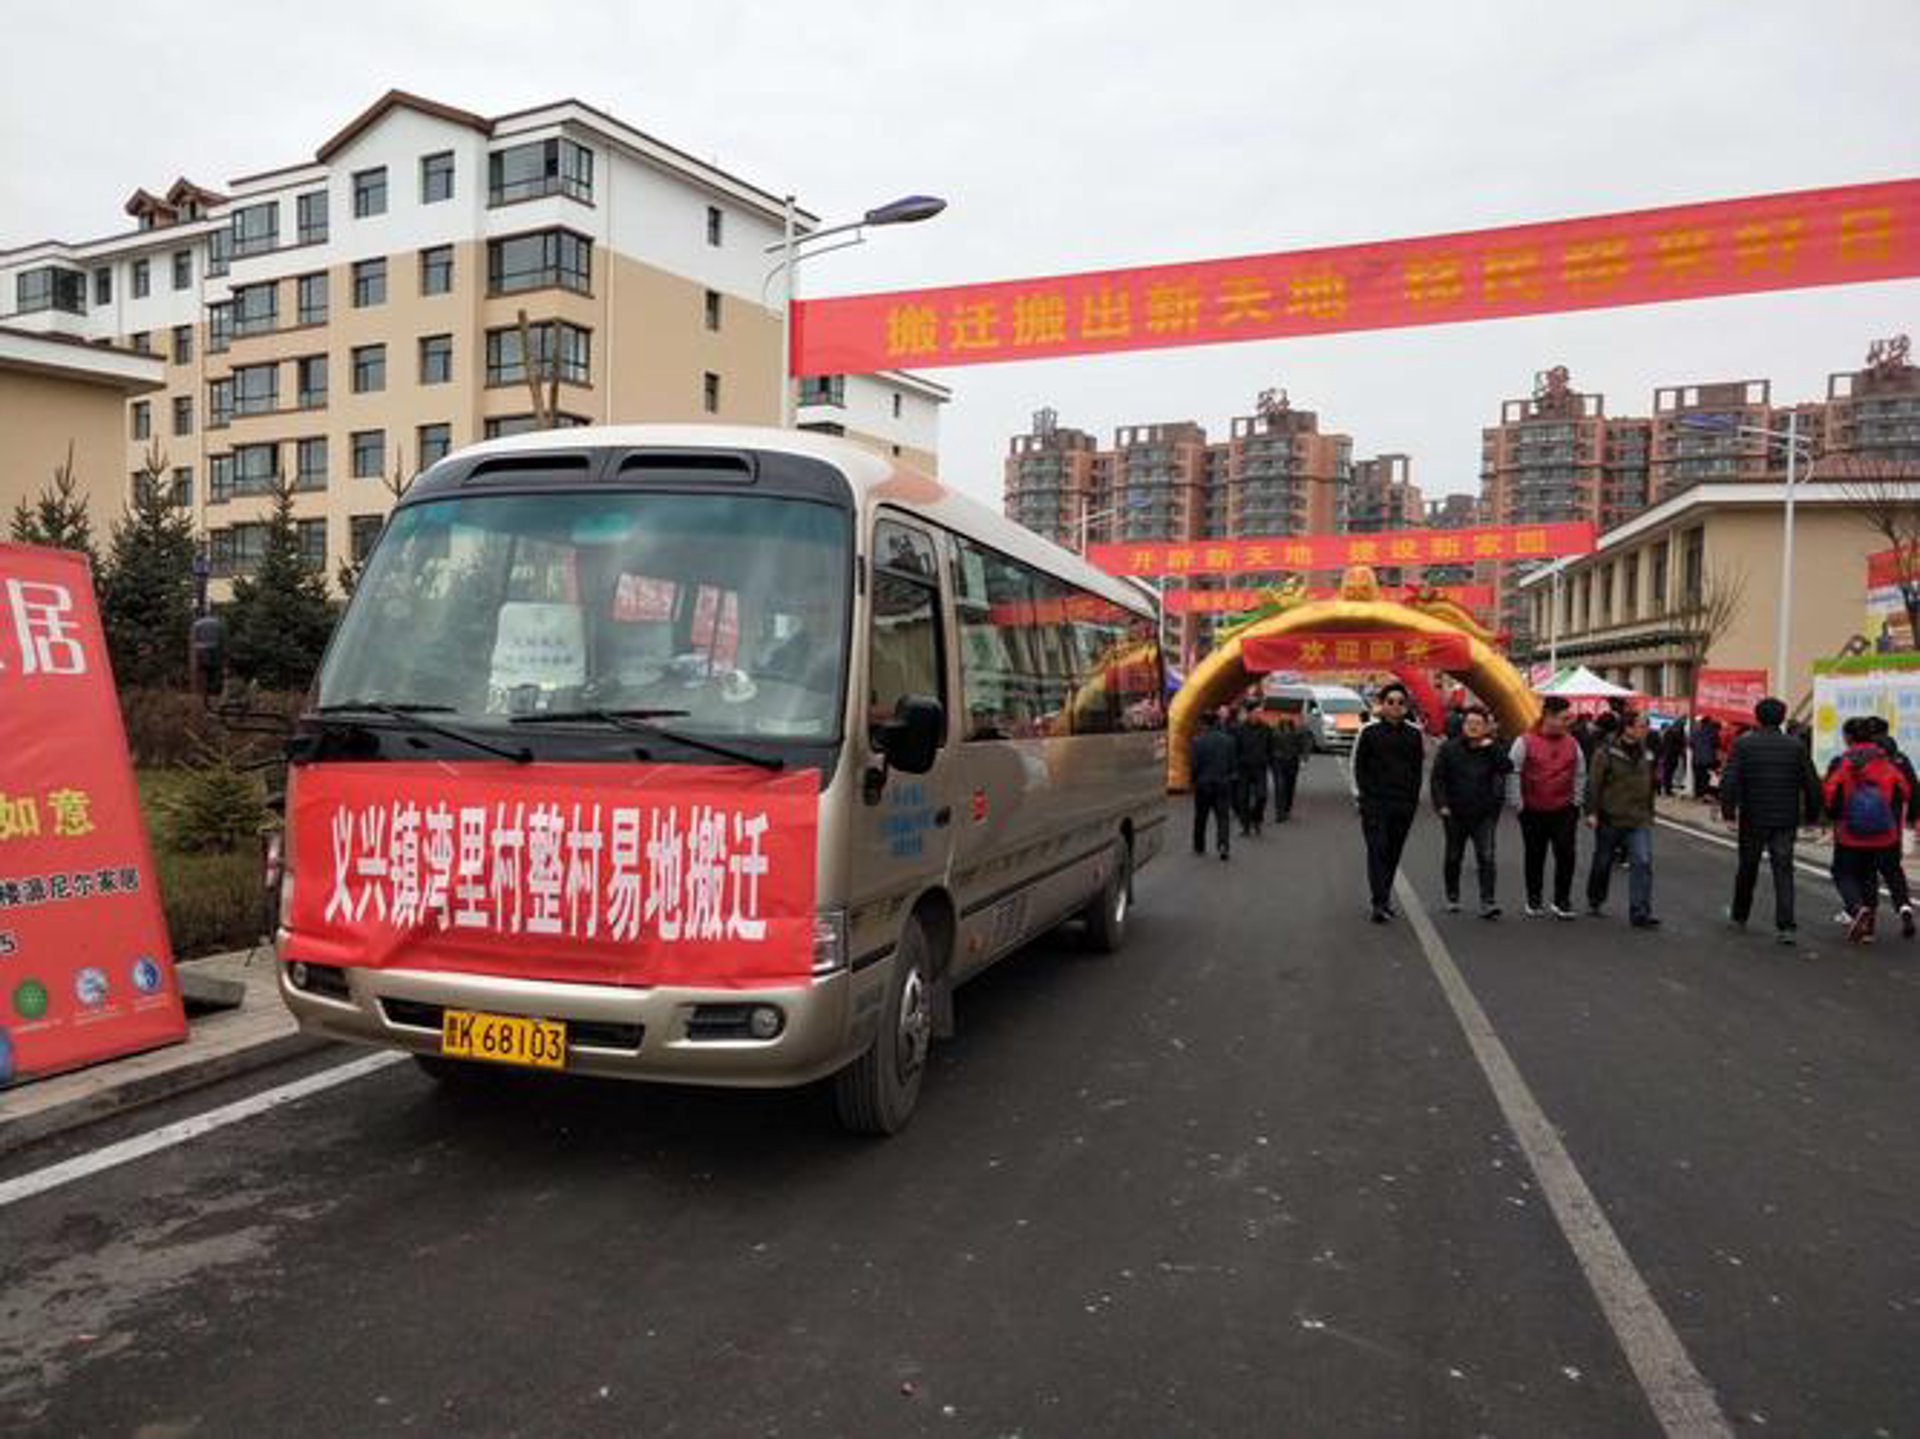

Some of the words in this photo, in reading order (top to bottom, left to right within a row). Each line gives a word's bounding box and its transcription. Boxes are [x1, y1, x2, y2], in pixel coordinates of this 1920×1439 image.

[886, 270, 1346, 356] 搬迁搬出新天地
[1348, 529, 1547, 561] 建设新家园
[5, 578, 88, 675] 居
[0, 788, 95, 838] 如意
[325, 801, 769, 941] 义兴镇湾里村整村易地搬迁
